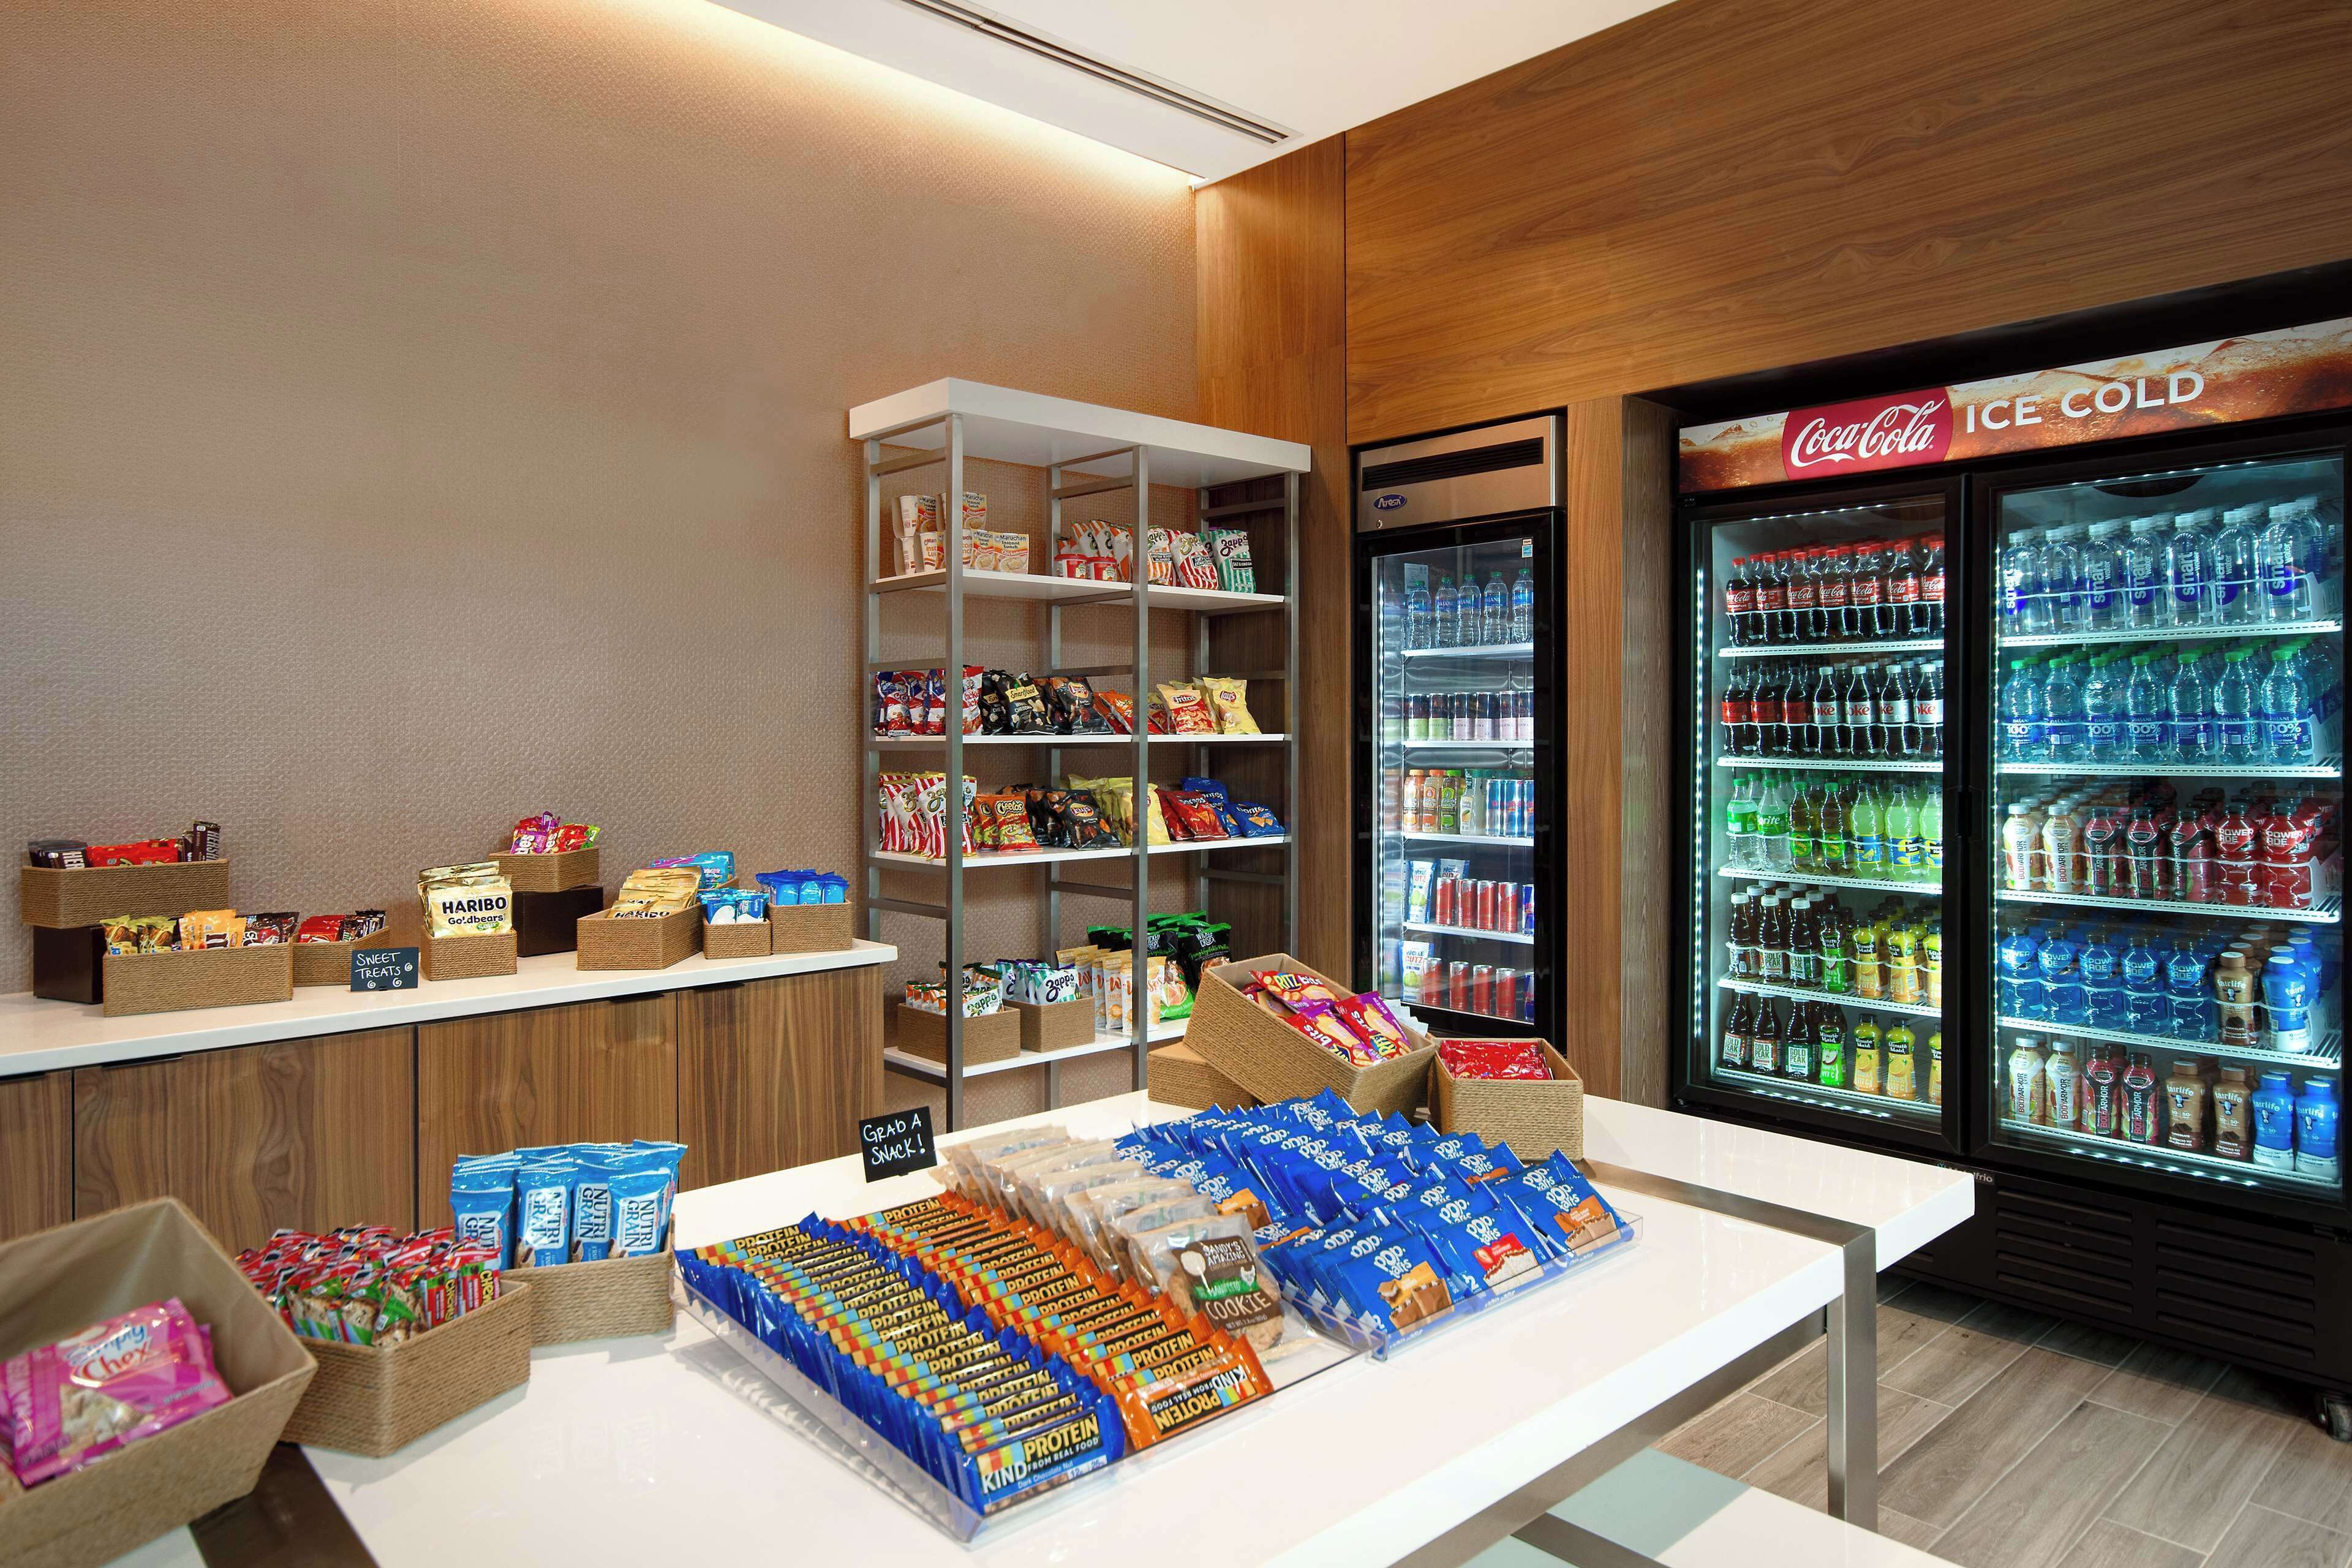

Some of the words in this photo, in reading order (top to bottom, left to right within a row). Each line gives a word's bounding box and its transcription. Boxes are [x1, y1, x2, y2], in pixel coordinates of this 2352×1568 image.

[1966, 394, 2042, 434] ICE
[2060, 371, 2204, 420] COLD
[1790, 396, 1947, 467] Coca-Cola
[2180, 552, 2195, 595] smart
[2270, 543, 2285, 589] smart
[1787, 588, 1814, 599] Coca-Cola
[1819, 585, 1847, 597] Coca-Cola
[1011, 686, 1036, 698] Smartfood
[1171, 695, 1196, 704] Fritos
[1814, 705, 1834, 716] oke
[1915, 705, 1936, 716] oke
[2087, 725, 2120, 734] 100%
[2128, 725, 2162, 734] 100%
[2271, 723, 2302, 733] 00%
[996, 801, 1023, 816] Cheetos
[442, 897, 507, 914] HARIBO
[1147, 934, 1160, 943] ICKED
[356, 952, 401, 967] SWEET
[2088, 957, 2117, 965] POWER
[2126, 961, 2158, 970] POWER
[355, 966, 401, 979] TREATS
[2174, 965, 2205, 973] POWER
[1274, 974, 1300, 991] RITZ
[1298, 975, 1322, 985] bits
[2218, 980, 2247, 989] fairlife
[1725, 1044, 1738, 1052] PEAK
[1726, 1037, 1738, 1046] GOLD
[1755, 1043, 1770, 1052] GOLD
[1755, 1050, 1770, 1058] PEAK
[1790, 1055, 1806, 1063] PEAK
[2167, 1085, 2194, 1096] fairlife
[2215, 1091, 2242, 1103] fairlife
[2253, 1100, 2280, 1112] fairlife
[911, 1114, 922, 1129] A
[582, 1187, 595, 1239] GRAIN
[593, 1188, 609, 1239] NUTRI
[885, 1199, 941, 1223] PROTEIN
[625, 1200, 641, 1248] GRAIN
[638, 1199, 655, 1248] NUTRI
[478, 1218, 496, 1250] NUT
[734, 1226, 800, 1250] PROTEIN
[747, 1232, 811, 1257] PROTEIN
[1203, 1240, 1242, 1256] SANDY'S
[1207, 1250, 1246, 1267] AMAZING
[1020, 1275, 1080, 1304] PROTEIN
[1039, 1288, 1099, 1314] PROTEIN
[1205, 1292, 1272, 1321] COOKIE
[895, 1320, 967, 1354] PROTEIN
[929, 1341, 1001, 1374] PROTEIN
[1131, 1332, 1194, 1370] PROTEIN
[80, 1338, 154, 1382] Chex
[1153, 1346, 1216, 1381] PROTEIN
[1210, 1366, 1248, 1388] KIND
[1153, 1389, 1222, 1431] PROTEIN
[1024, 1413, 1099, 1461] PROTEIN
[982, 1461, 1028, 1494] KIND
[1027, 1457, 1052, 1472] FROM
[1053, 1448, 1076, 1463] REAL
[1076, 1438, 1099, 1453] FOOD
[1017, 1479, 1031, 1490] Dark
[1033, 1466, 1062, 1483] Chocolate
[1062, 1460, 1074, 1471] Nut
